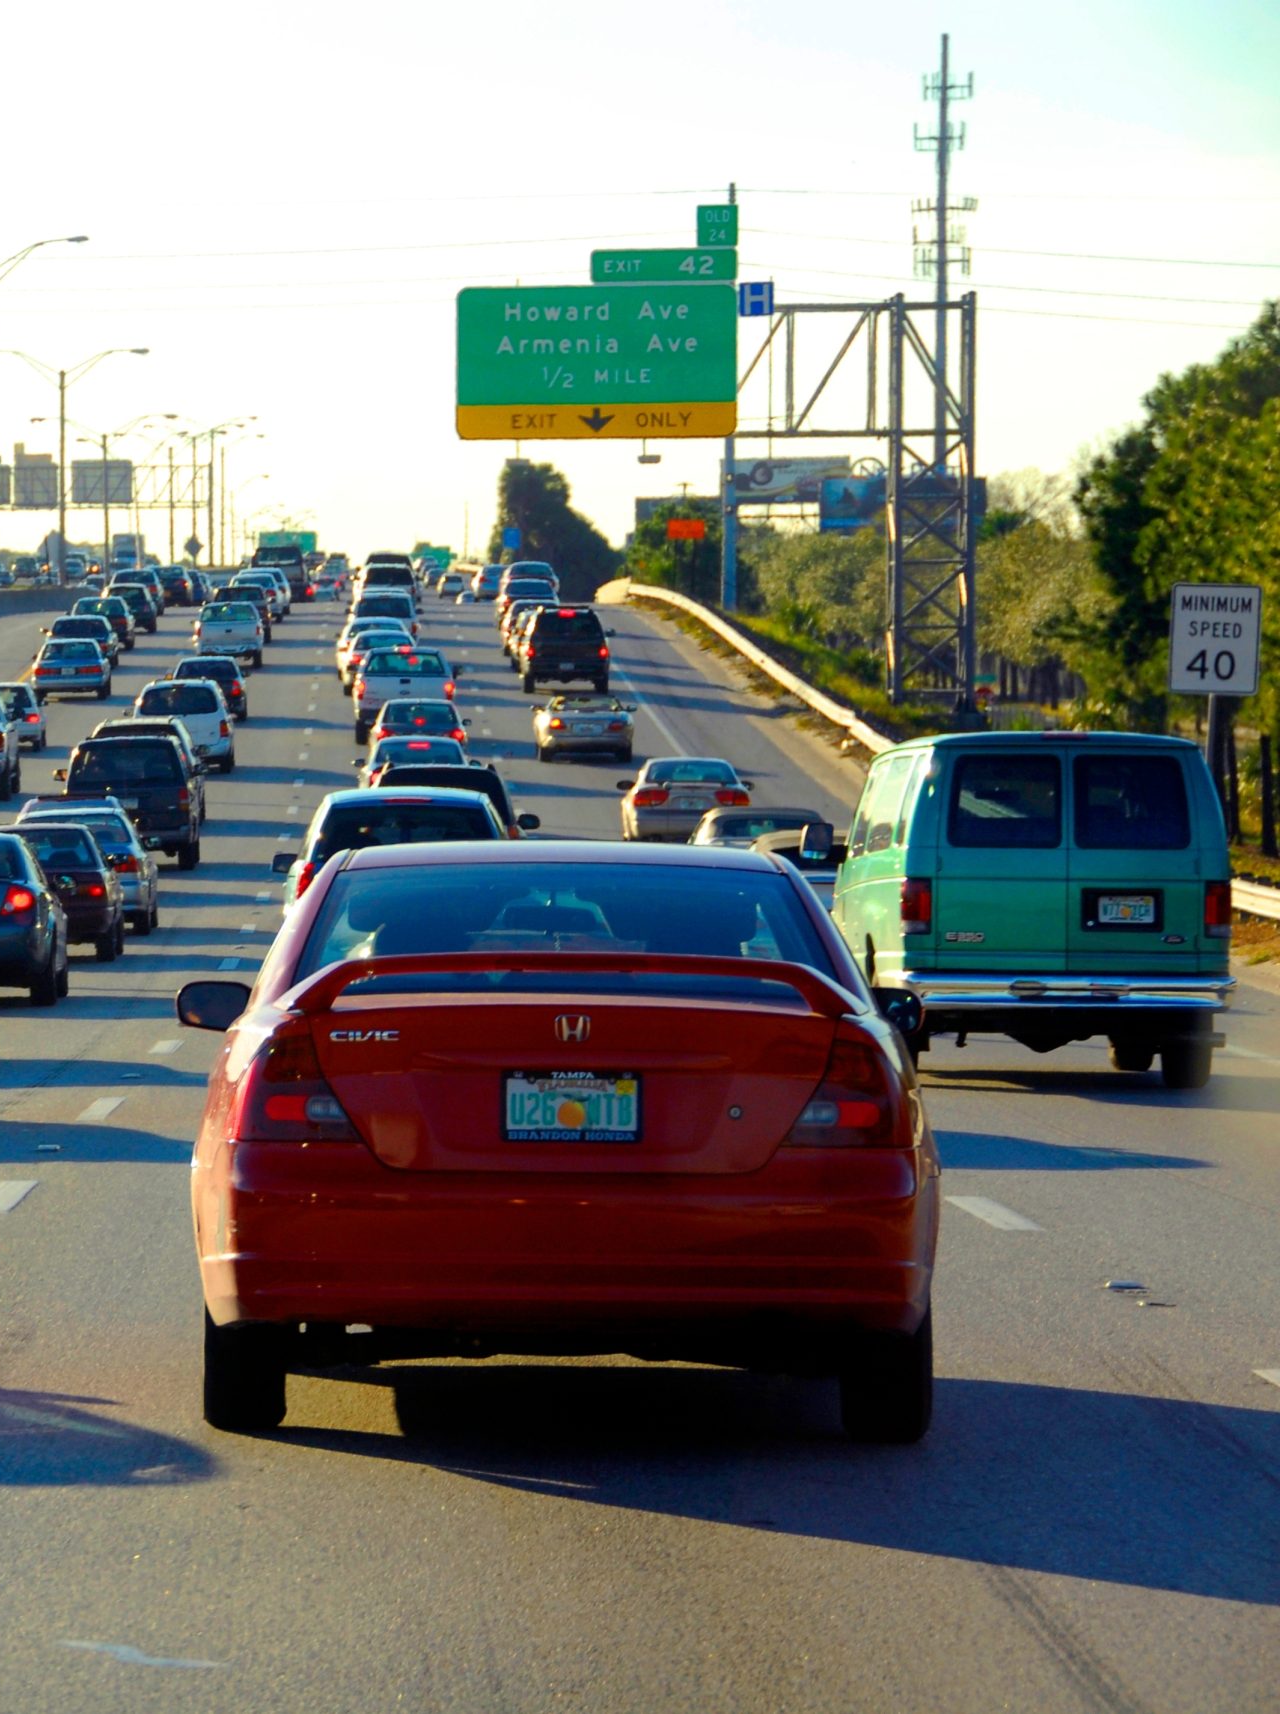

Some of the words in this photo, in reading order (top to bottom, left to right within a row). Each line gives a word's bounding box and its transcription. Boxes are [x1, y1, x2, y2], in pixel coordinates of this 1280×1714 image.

[705, 210, 730, 222] OLD
[709, 229, 726, 241] 24
[604, 259, 642, 273] EXIT
[679, 255, 715, 275] 42
[744, 283, 770, 315] H
[504, 302, 610, 322] Howard
[638, 301, 689, 320] Ave
[497, 334, 618, 355] Armenia
[647, 334, 698, 352] Ave
[595, 368, 651, 384] MILE
[511, 413, 557, 430] EXIT
[635, 411, 692, 428] ONLY
[1181, 595, 1253, 613] MINIMUM
[1188, 620, 1242, 638] SPEED
[1186, 649, 1236, 680] 40
[329, 1030, 400, 1042] CIVIC
[551, 1071, 595, 1079] TAMPA
[510, 1092, 557, 1126] U26
[508, 1131, 581, 1141] BRANDON
[585, 1131, 636, 1142] HONDA
